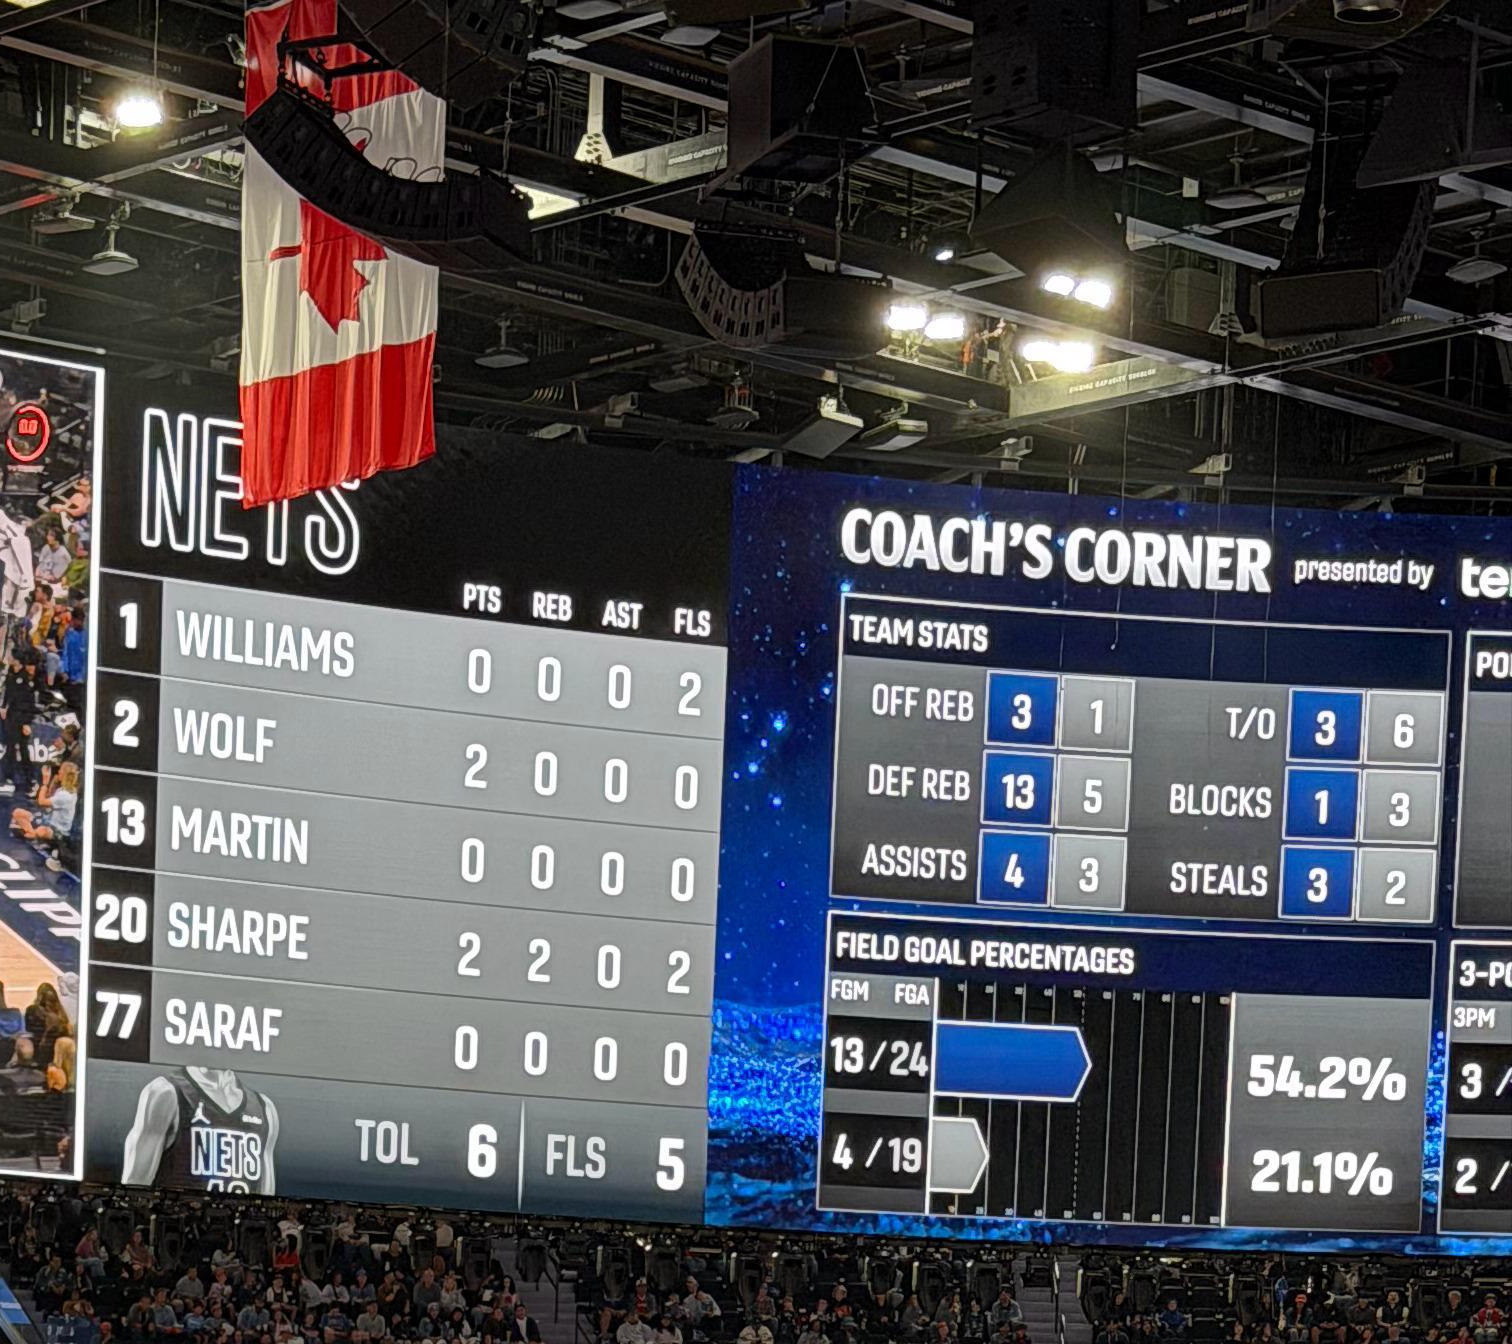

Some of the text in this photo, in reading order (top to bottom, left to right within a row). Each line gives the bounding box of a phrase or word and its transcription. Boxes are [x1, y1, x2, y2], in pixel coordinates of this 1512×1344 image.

[840, 508, 1053, 580] COACH'S
[1064, 529, 1272, 594] CORNER
[1294, 558, 1402, 585] presented
[1406, 560, 1434, 589] by
[463, 582, 711, 637] PTS REB AST FLS
[849, 615, 989, 653] TEAM STATS
[119, 602, 701, 716] 1 WILLIAMS 2
[871, 684, 1103, 735] OFF REB 3 1
[1226, 707, 1415, 749] T/O 3 6
[112, 700, 488, 789] 2 WOLF 2
[868, 764, 1103, 815] DEF REB 13 5
[1169, 784, 1410, 828] BLOCKS 1 3
[101, 798, 309, 865] 13 MARTIN
[862, 844, 1100, 893] ASSISTS 4 3
[1170, 862, 1406, 906] STEALS 3 2
[93, 895, 691, 995] 20 SHARPE 2 2 2
[836, 931, 1135, 975] FIELD GOAL PERCENTAGES
[830, 979, 930, 1005] FGM FGA
[95, 992, 282, 1054] 77 SARAF
[1454, 1007, 1496, 1029] 3PM
[830, 1036, 928, 1077] 13 24
[1247, 1055, 1407, 1103] 54.2%
[1460, 1063, 1482, 1099] 3
[191, 1126, 262, 1180] NETS
[354, 1119, 685, 1192] TOL 6 FLS 5
[832, 1133, 922, 1173] 4 19
[1251, 1150, 1393, 1196] 21.1%
[1455, 1159, 1477, 1195] 2
